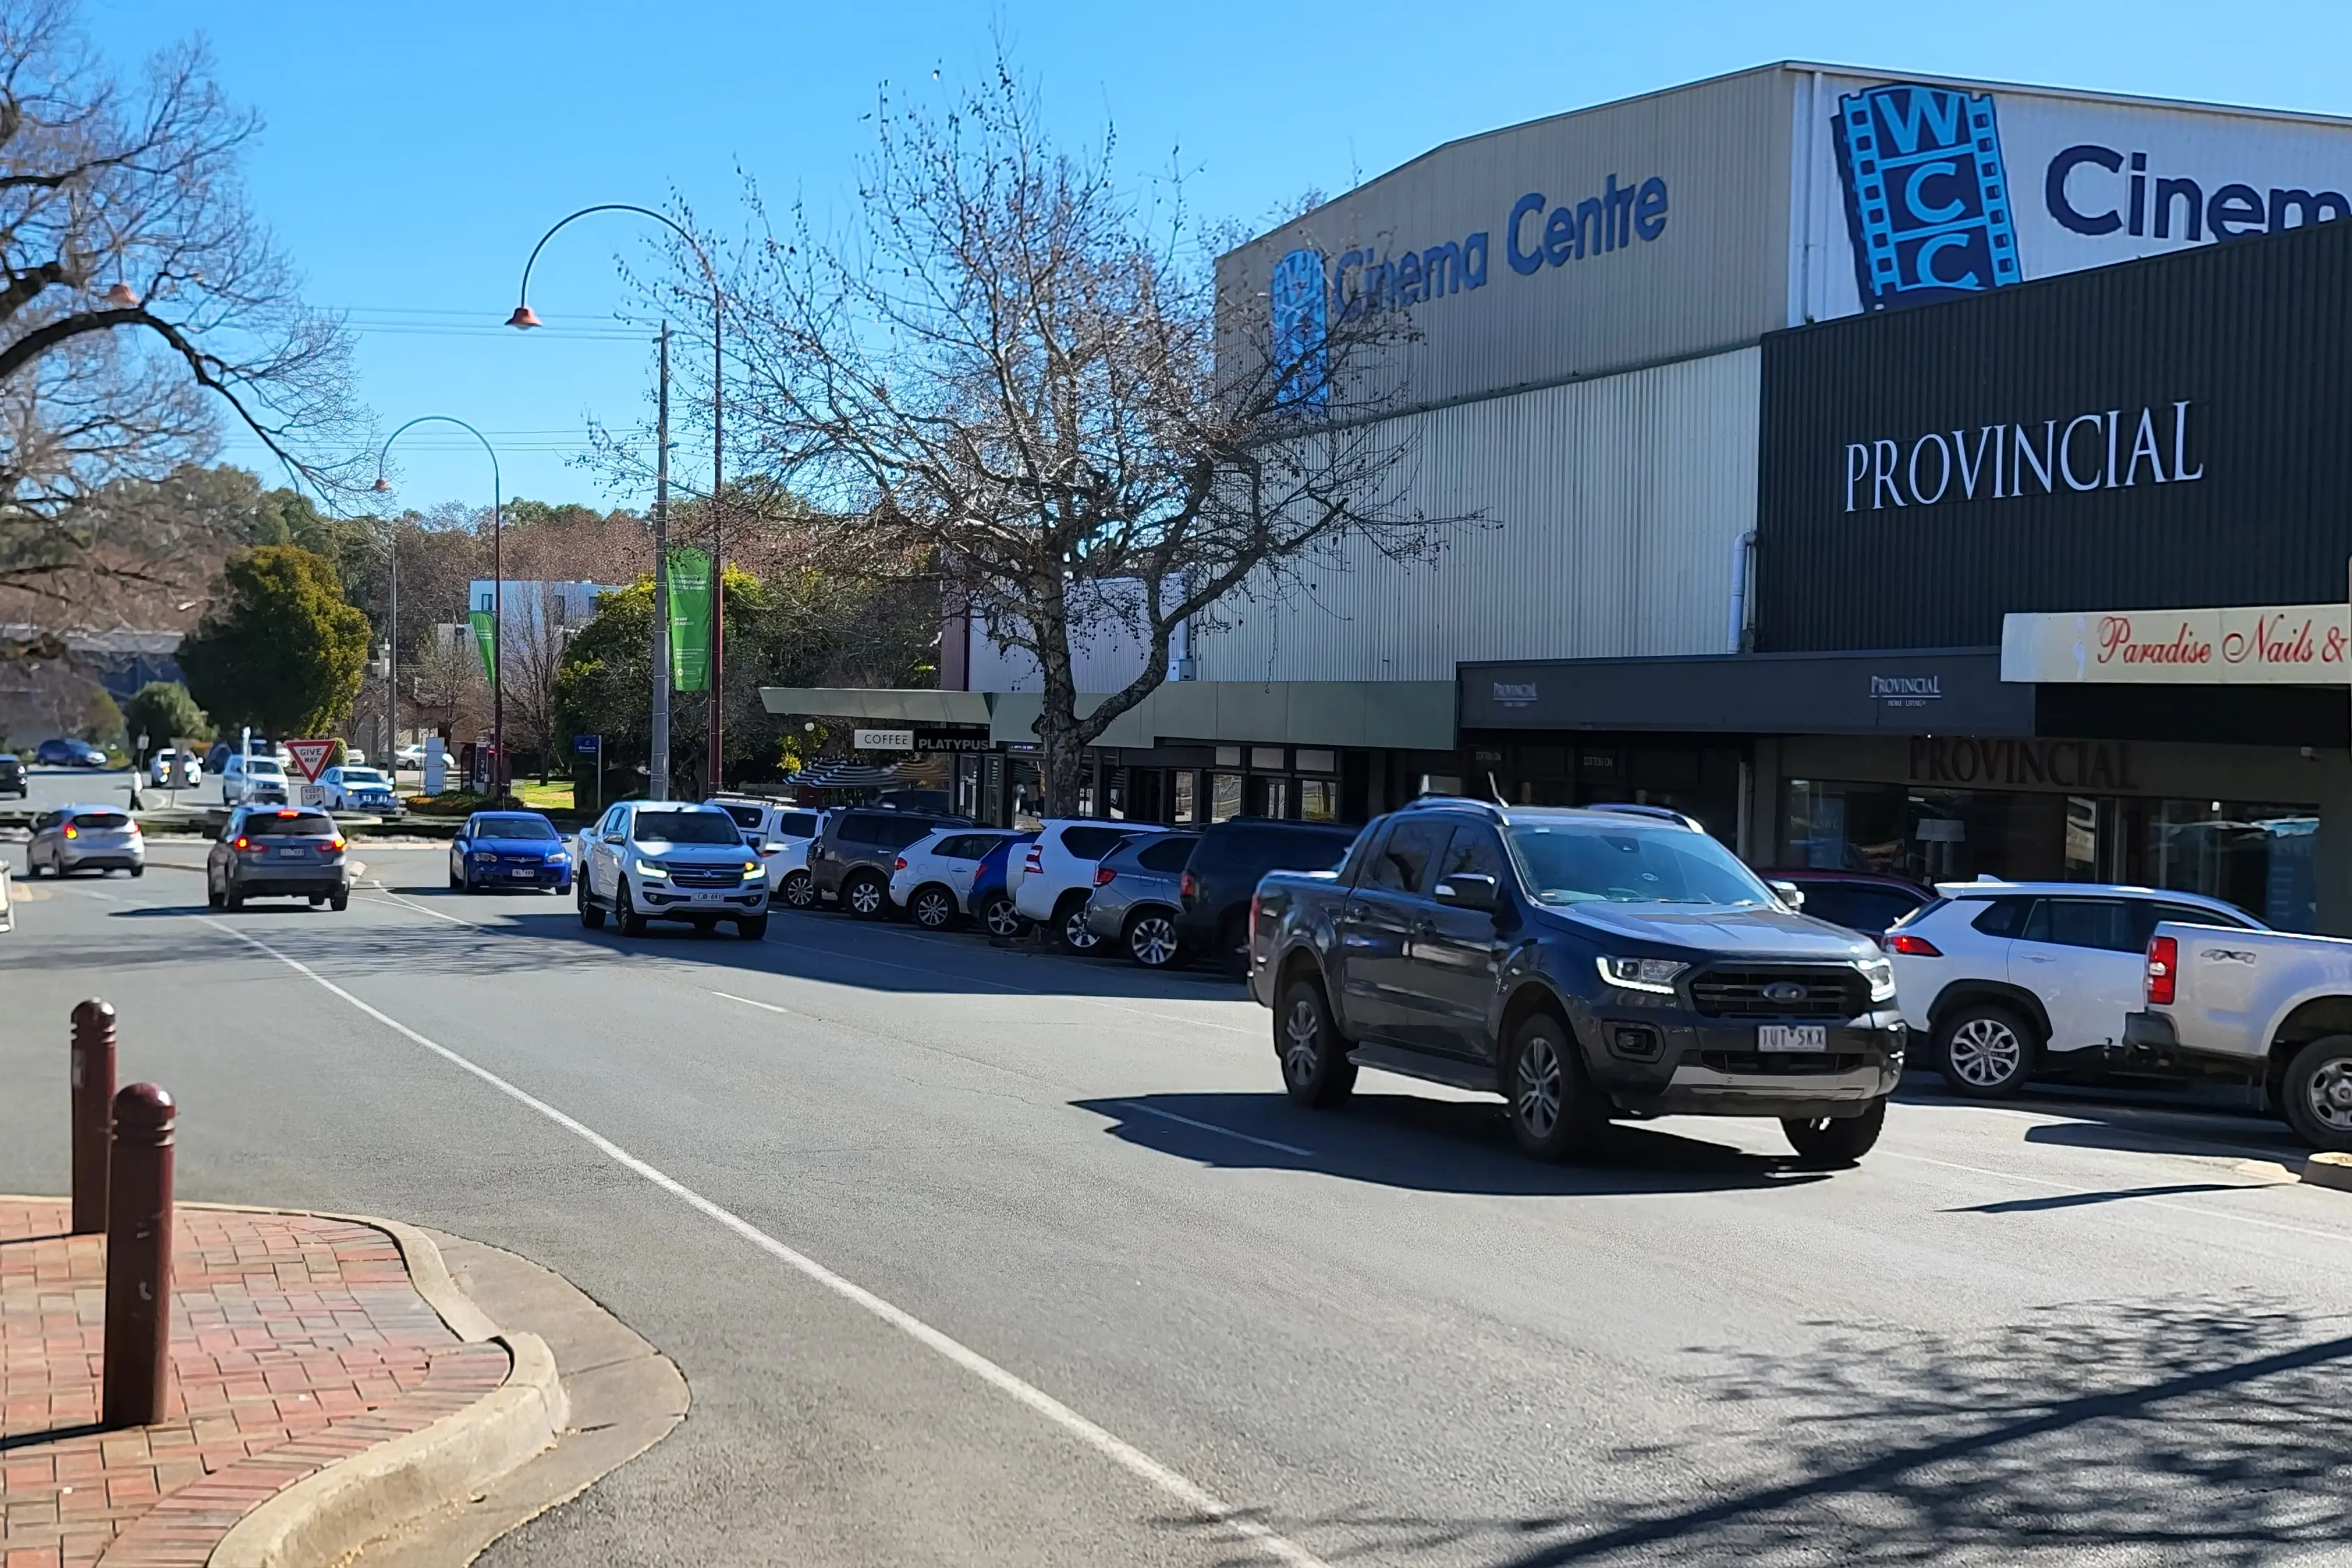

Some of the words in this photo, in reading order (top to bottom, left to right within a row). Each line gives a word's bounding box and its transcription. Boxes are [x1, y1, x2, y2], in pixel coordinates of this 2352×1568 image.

[1507, 173, 1668, 275] Centre
[1845, 400, 2204, 512] PROVINCIAL
[2097, 616, 2212, 664] Paradise
[2222, 614, 2313, 664] Nails
[2322, 627, 2349, 663] &
[1871, 675, 1941, 693] PROVINCIAL
[864, 735, 908, 745] COFFEE
[918, 739, 989, 751] PLATYPUS
[1908, 738, 2140, 790] PROVINCIAL
